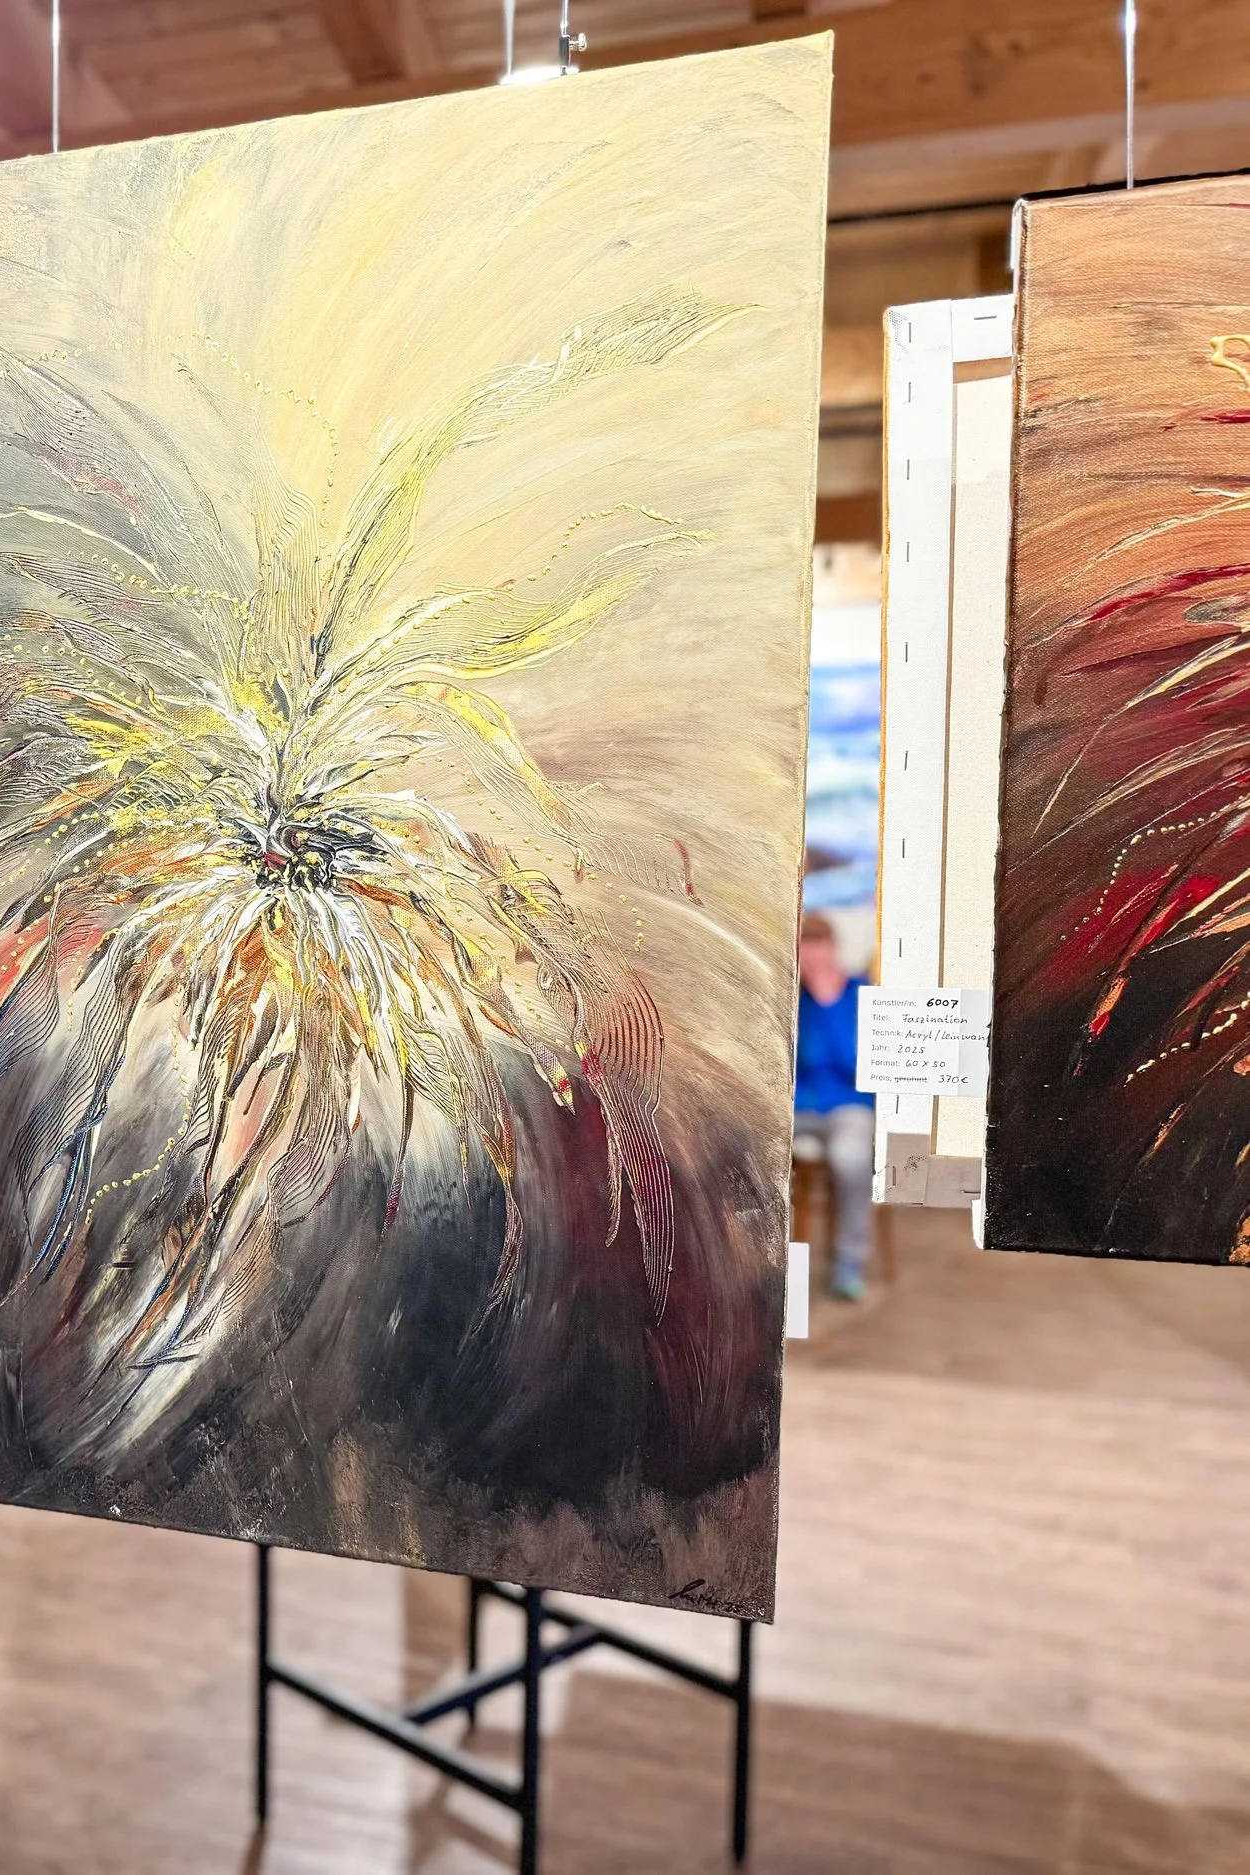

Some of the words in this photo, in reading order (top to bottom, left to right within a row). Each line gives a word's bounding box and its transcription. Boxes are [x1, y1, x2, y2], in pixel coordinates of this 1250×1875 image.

[872, 999, 917, 1008] Künstler/in:
[926, 998, 959, 1009] 6007
[902, 1013, 968, 1024] Faszination
[872, 1029, 903, 1037] Technik:
[897, 1044, 926, 1054] 2025
[870, 1059, 901, 1067] Format:
[905, 1059, 918, 1068] 60
[931, 1060, 946, 1068] 50
[938, 1074, 969, 1084] 370€
